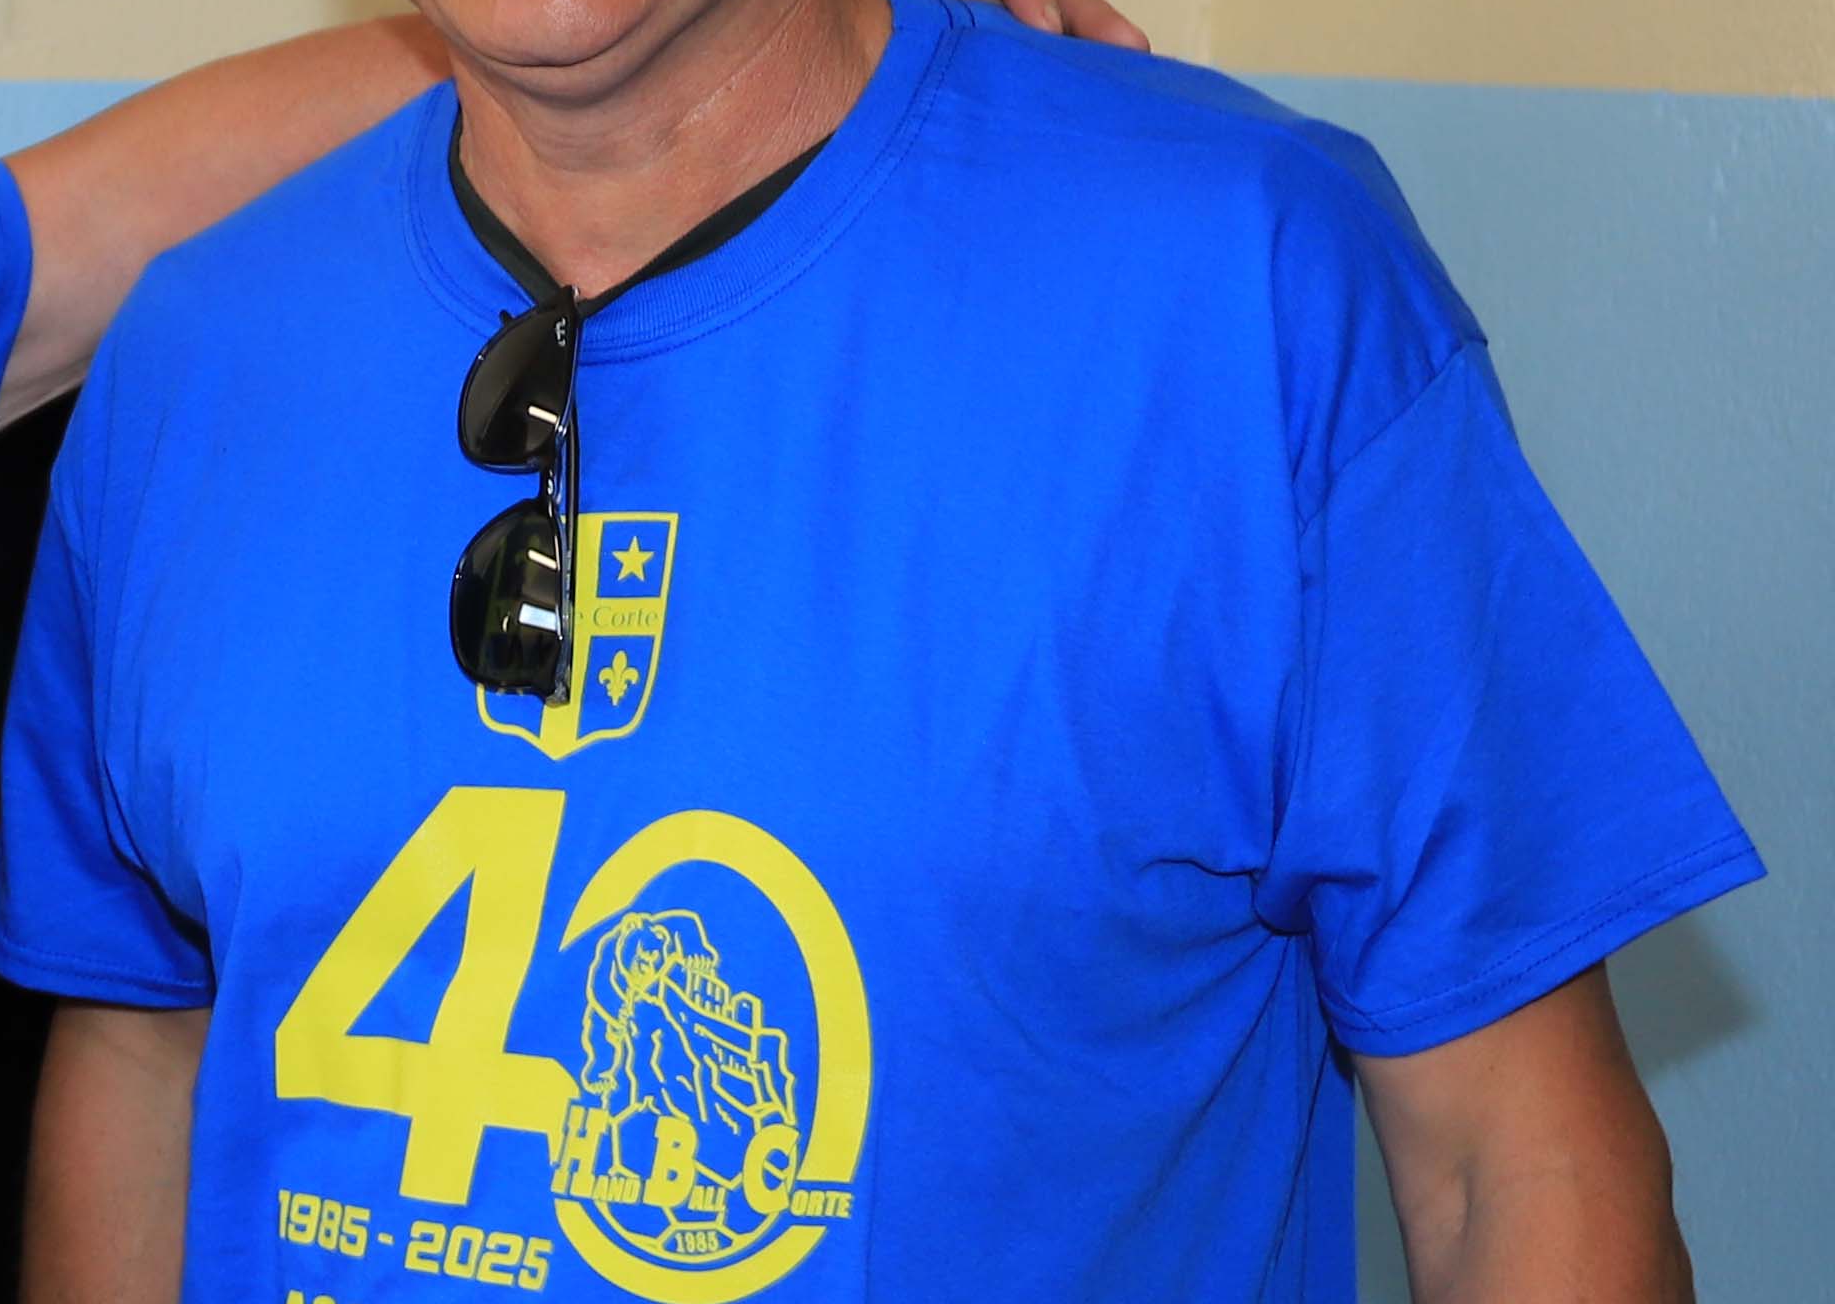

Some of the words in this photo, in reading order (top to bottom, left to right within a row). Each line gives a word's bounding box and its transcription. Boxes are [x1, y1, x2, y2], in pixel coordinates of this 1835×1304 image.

[593, 604, 659, 629] Corte
[279, 1190, 371, 1258] 1985
[404, 1220, 553, 1291] 2025
[675, 1231, 719, 1253] 1985
